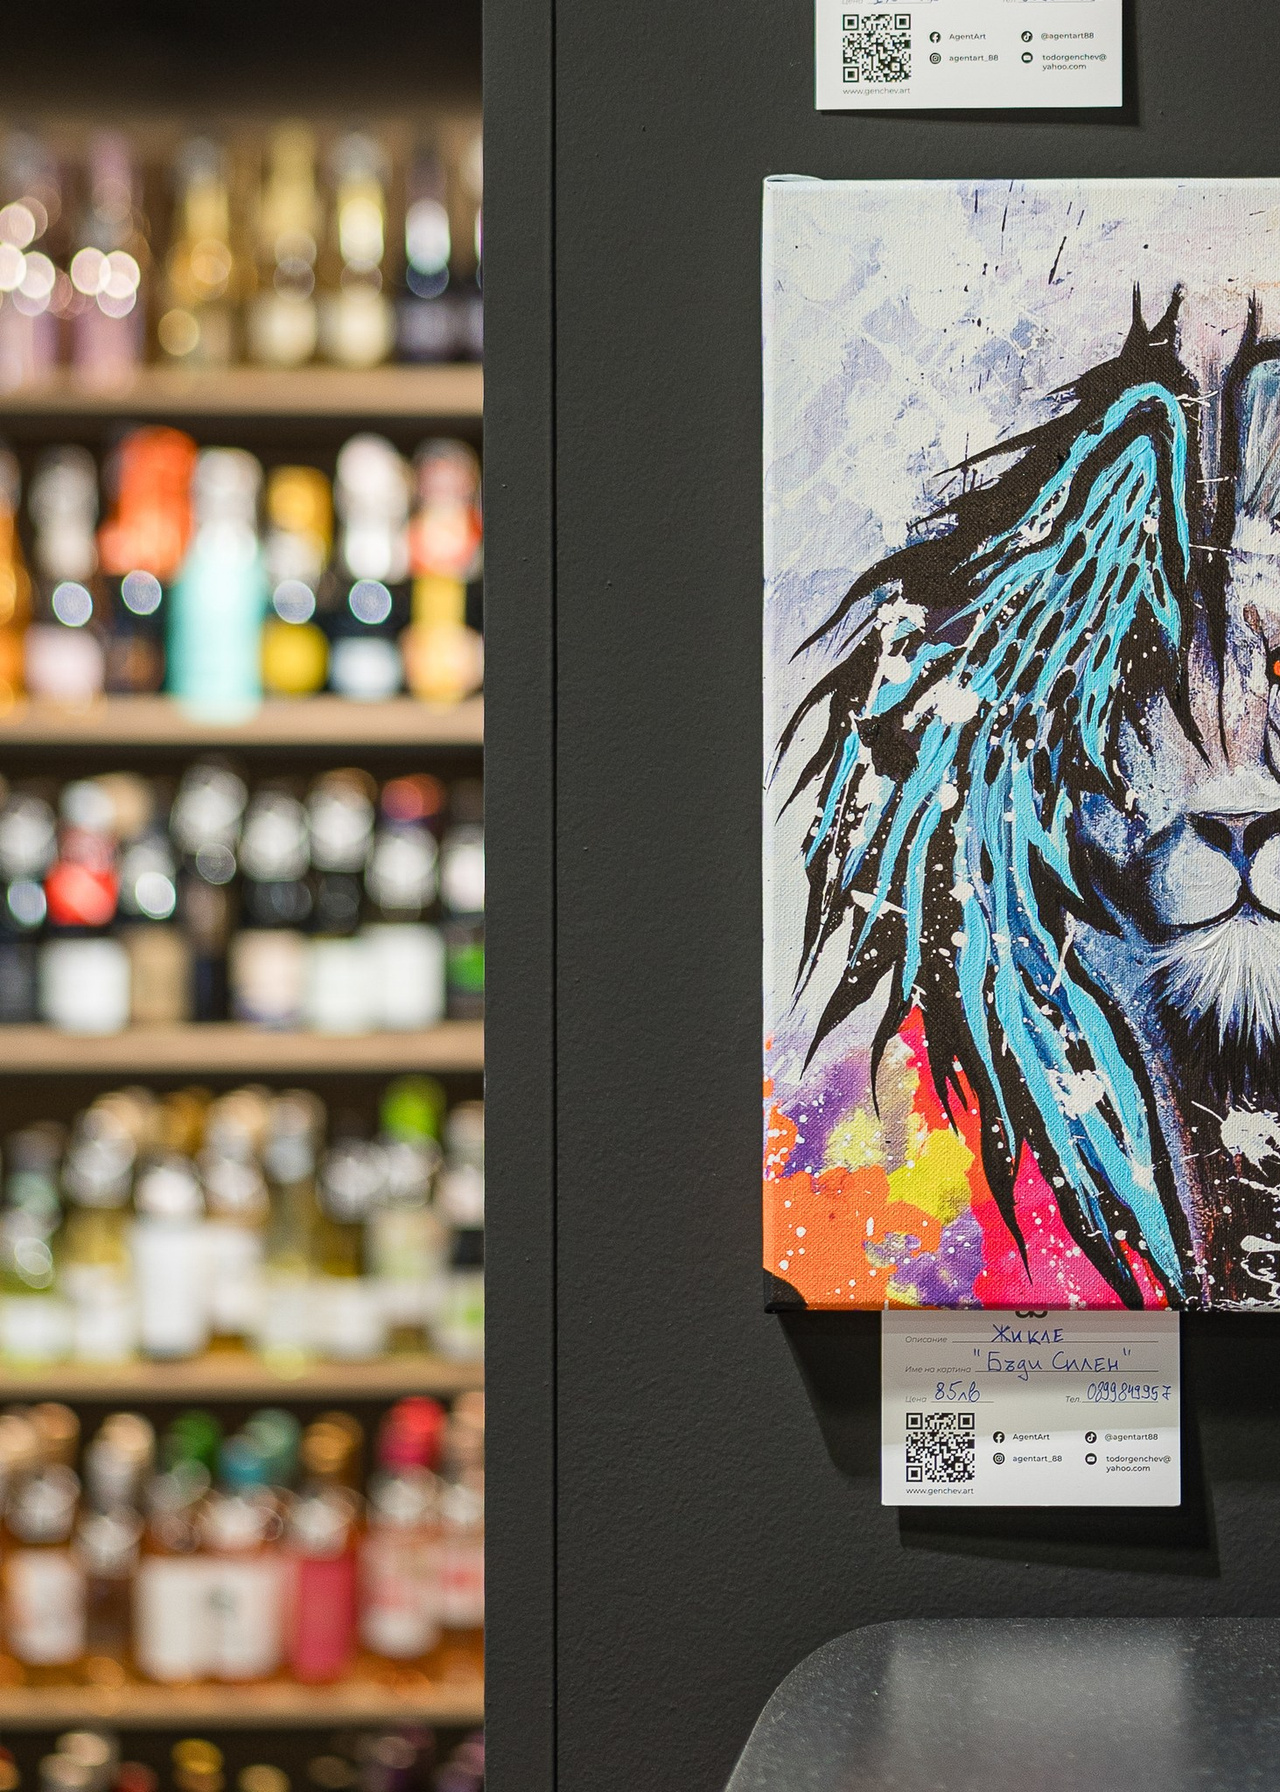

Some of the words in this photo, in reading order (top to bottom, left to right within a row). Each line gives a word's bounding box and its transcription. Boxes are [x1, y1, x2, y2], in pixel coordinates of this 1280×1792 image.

[949, 32, 986, 42] AgentArt
[1041, 32, 1094, 41] @agentart88
[1042, 53, 1107, 62] todorgenchev@
[1042, 63, 1087, 71] yahoo.com
[842, 87, 911, 96] www.genchev.art
[905, 1335, 948, 1344] Описание
[904, 1366, 923, 1374] Име
[936, 1366, 972, 1375] картина
[905, 1395, 927, 1404] Цена
[1012, 1432, 1050, 1442] AgentArt
[1104, 1433, 1159, 1443] @agentart88
[1012, 1454, 1063, 1464] agentart_88
[1106, 1454, 1172, 1464] todorgenchev@
[1106, 1464, 1151, 1473] yahoo.com
[906, 1486, 975, 1496] www.genchev.art
